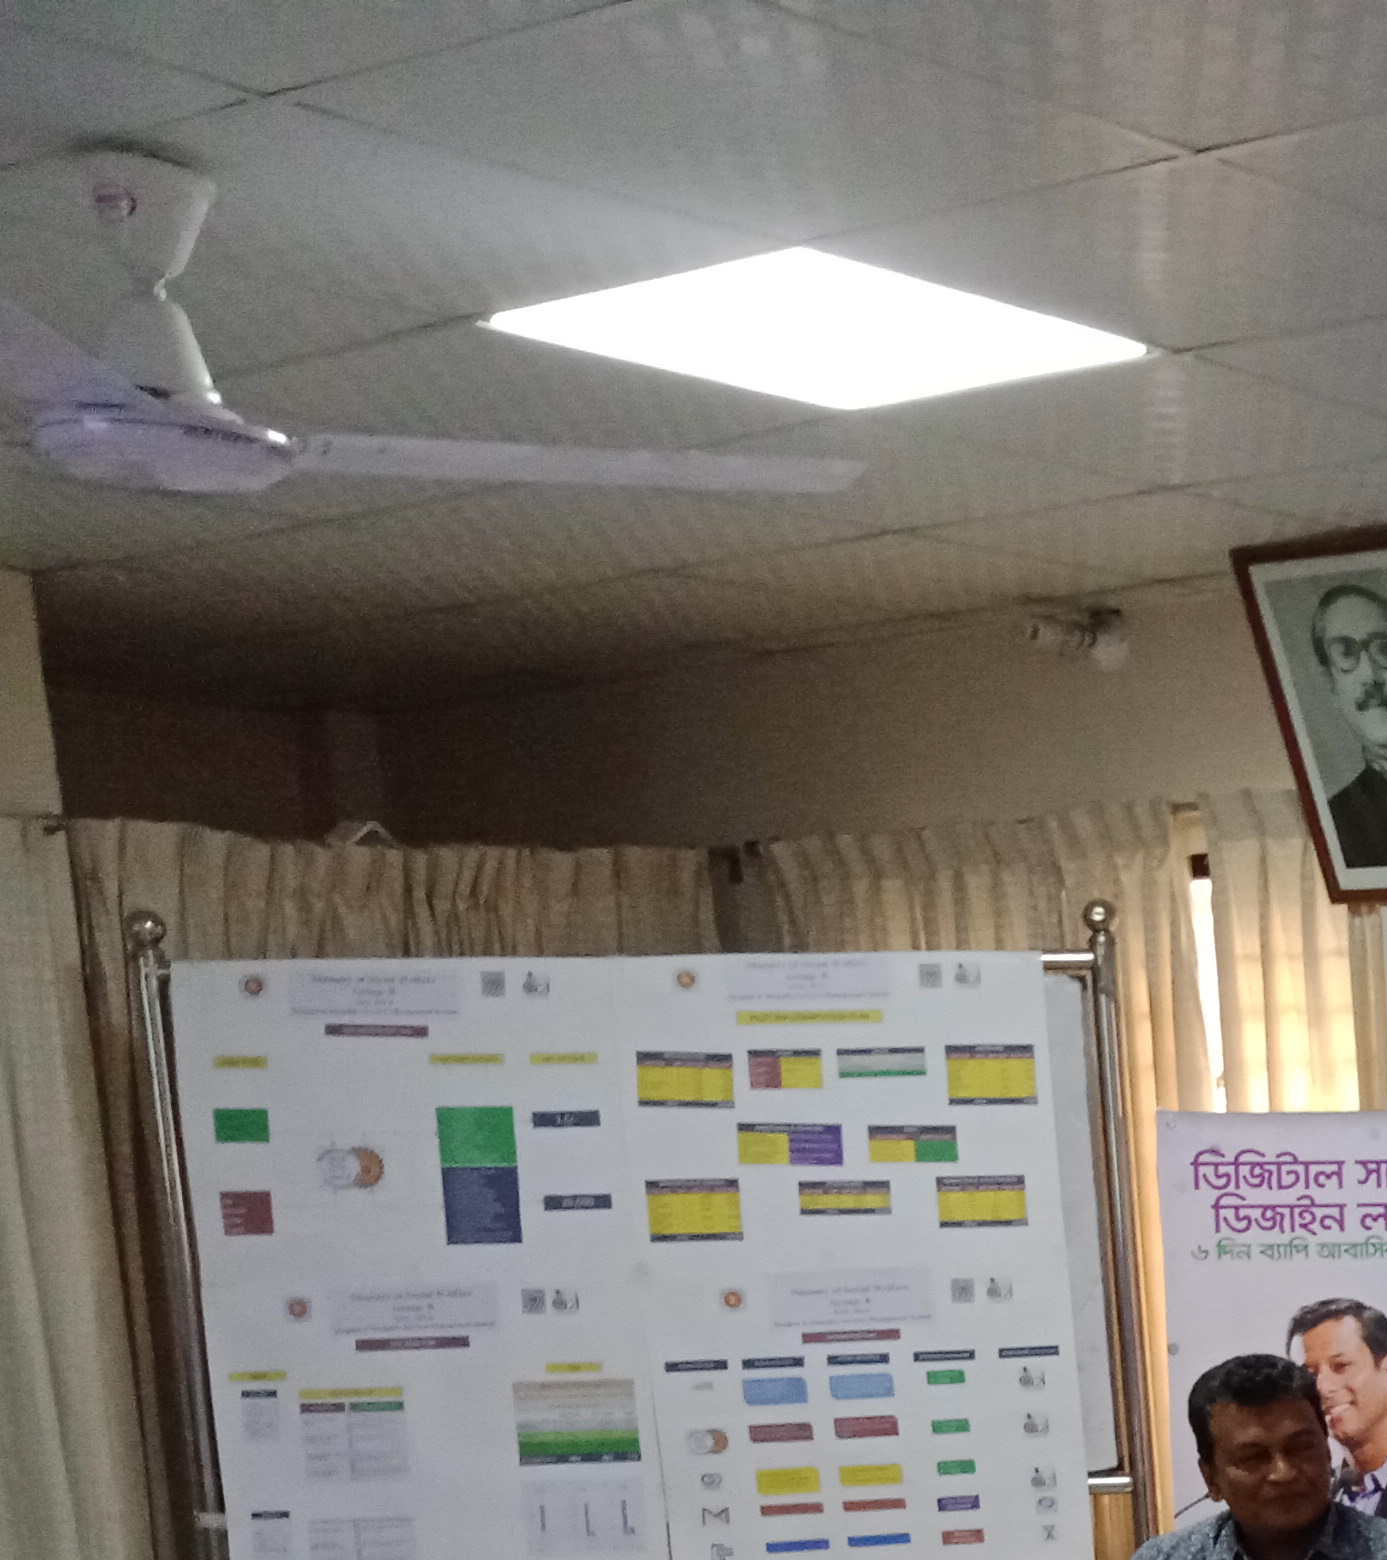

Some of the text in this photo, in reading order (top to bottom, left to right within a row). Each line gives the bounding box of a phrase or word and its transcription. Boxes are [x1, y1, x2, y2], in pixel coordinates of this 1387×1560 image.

[1190, 1149, 1346, 1192] ডিজিটাল
[1211, 1192, 1347, 1236] ডিজাইন
[1191, 1245, 1209, 1261] ৬
[1216, 1238, 1252, 1262] দিন
